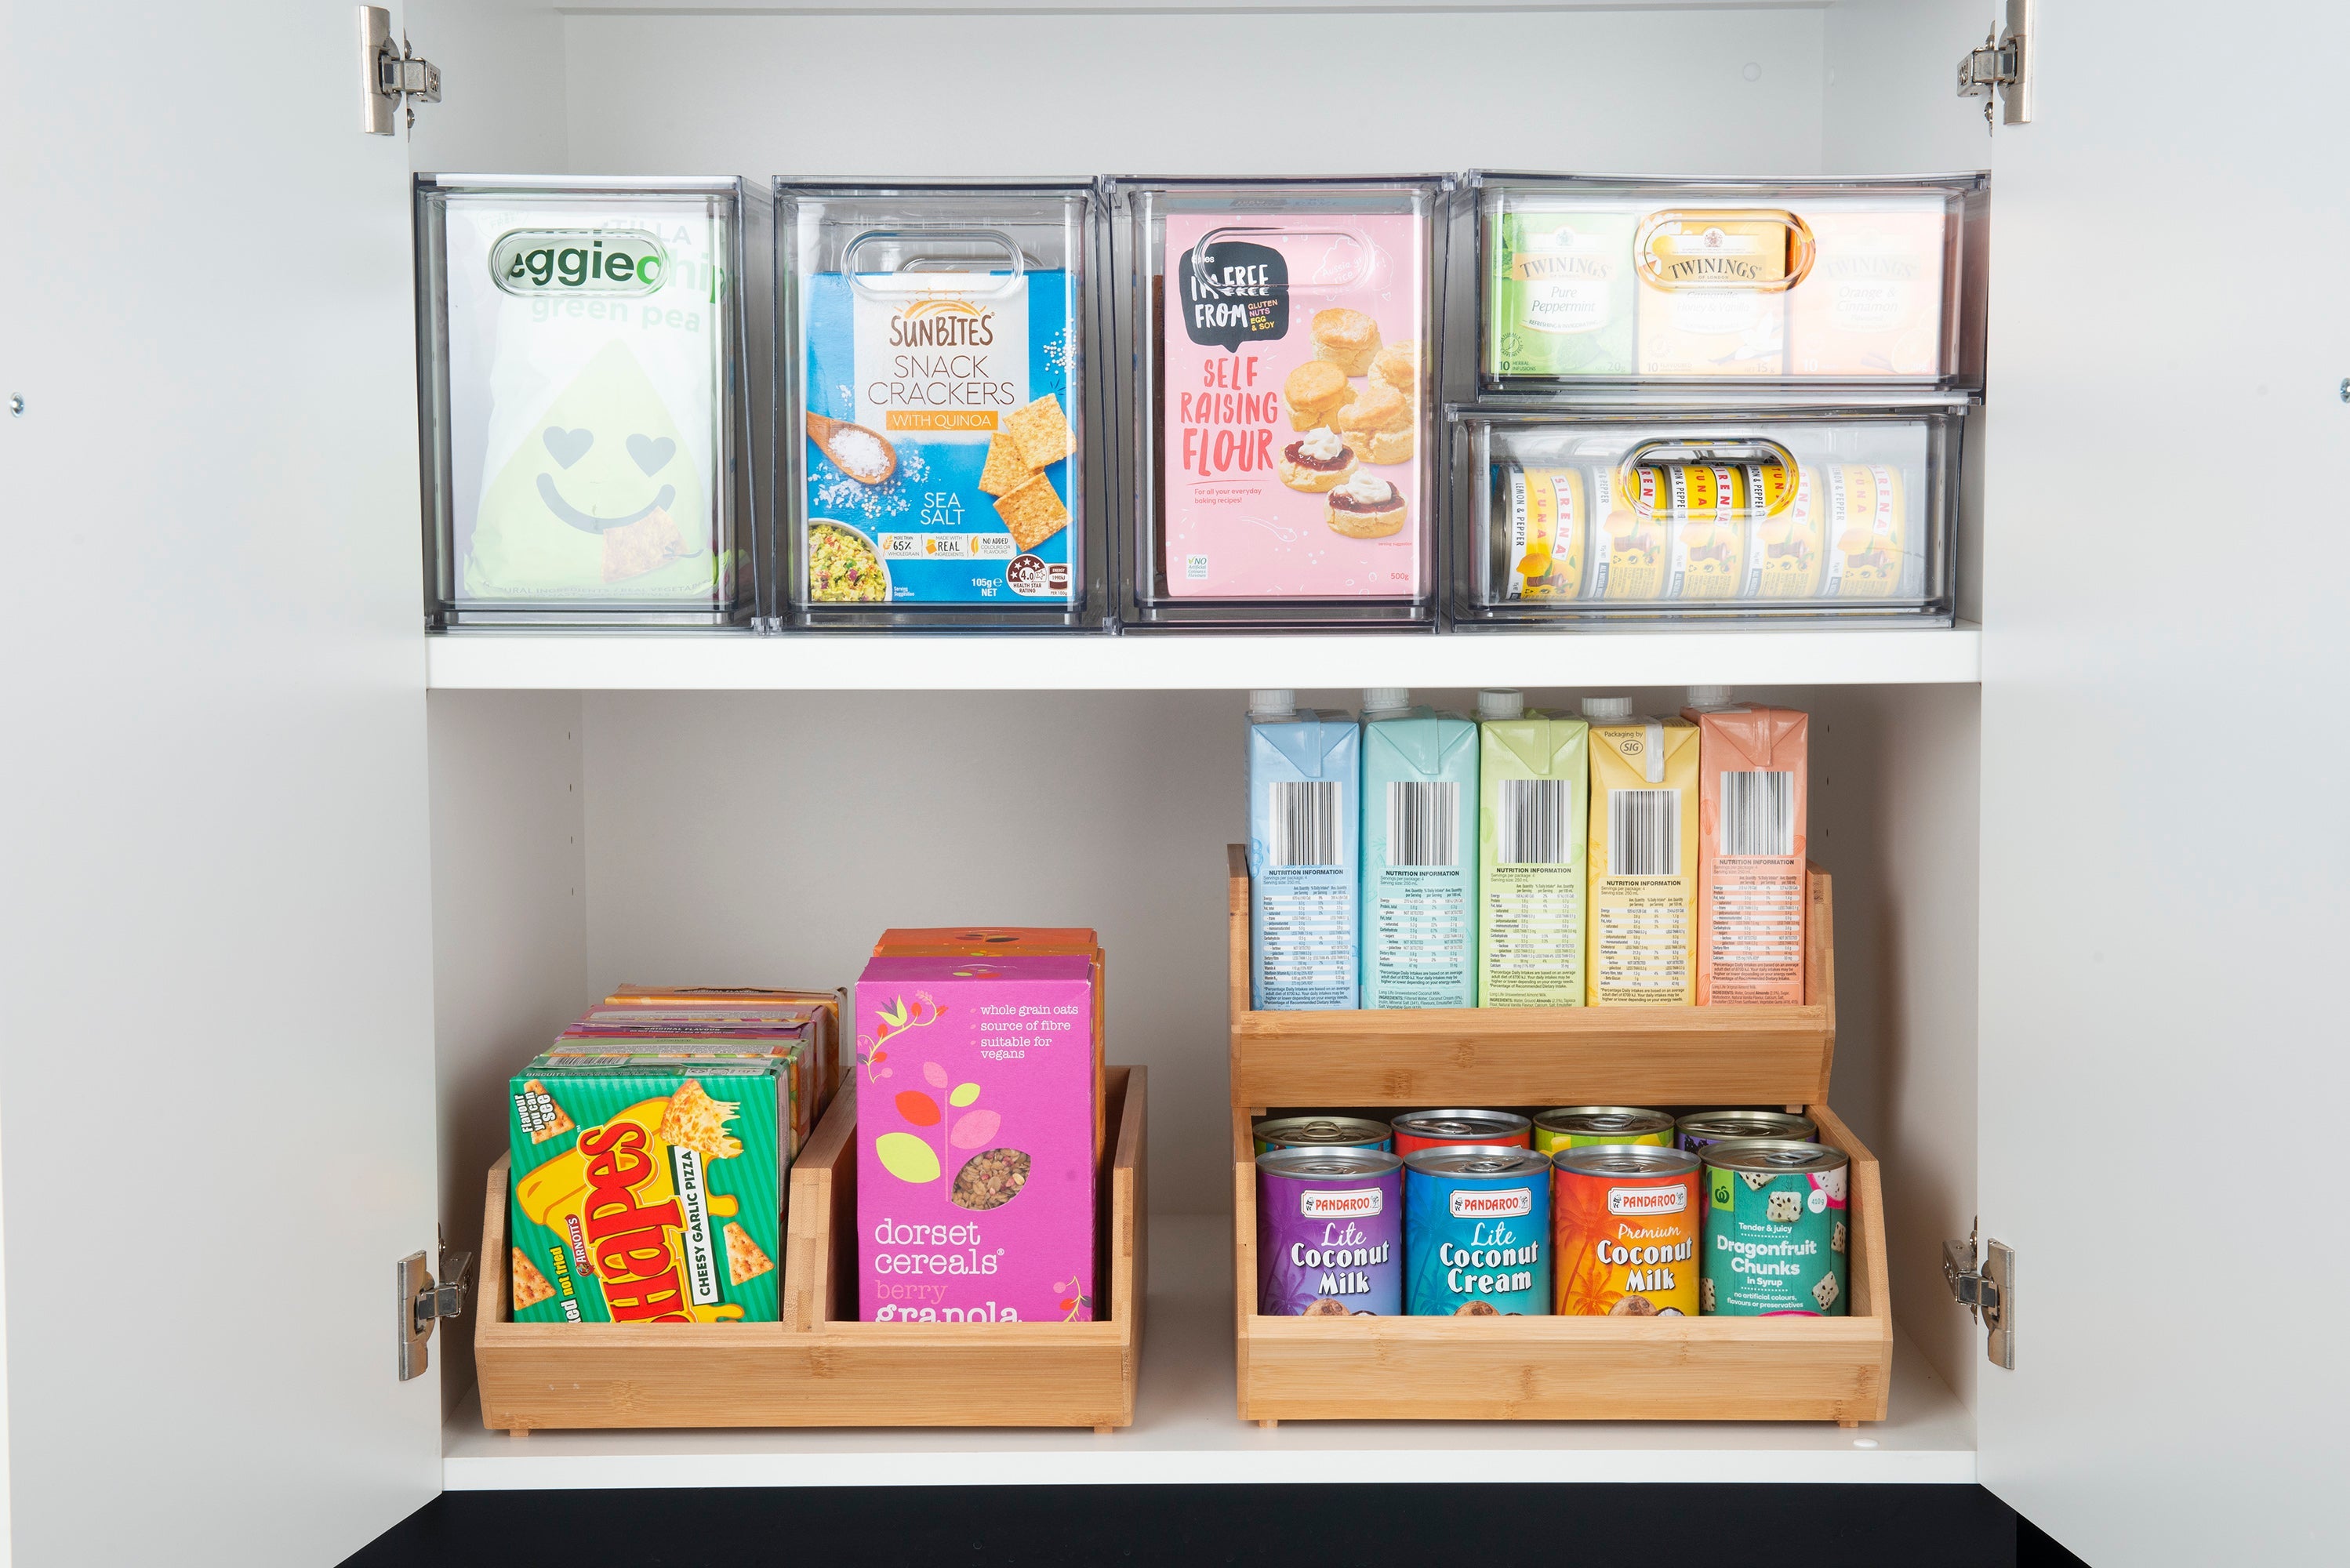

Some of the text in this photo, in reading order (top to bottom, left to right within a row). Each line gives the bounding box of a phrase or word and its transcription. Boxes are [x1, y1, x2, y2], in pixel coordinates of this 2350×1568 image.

[1520, 257, 1609, 278] TWININGS
[1669, 258, 1758, 279] TWININGS
[1551, 286, 1578, 298] Pure
[1839, 286, 1882, 301] Orange
[532, 298, 699, 332] green pea
[1195, 303, 1248, 328] FROM
[1248, 299, 1278, 310] GLUTEN
[1249, 307, 1270, 317] NUTS
[1531, 300, 1596, 314] Peppermint
[1836, 301, 1898, 312] Cinnamon
[889, 314, 993, 347] SUNBITES
[1250, 316, 1266, 325] EGG
[1259, 321, 1275, 330] SOY
[1529, 319, 1556, 328] REFRESHING
[894, 355, 989, 378] SNACK
[1204, 356, 1259, 390] SELF
[1499, 361, 1509, 371] 10
[1647, 363, 1658, 372] 10
[868, 382, 1015, 405] CRACKERS
[1181, 392, 1277, 425] RAISING
[892, 414, 991, 429] WITH QUINOA
[1183, 428, 1273, 476] FLOUR
[1516, 482, 1524, 505] LEMON
[1694, 470, 1707, 506] TUNA
[1854, 471, 1867, 514] TUNA
[1869, 465, 1890, 528] SIRENA
[924, 492, 961, 508] SEA
[1836, 492, 1844, 521] PEPPER
[920, 509, 965, 525] SALT
[1537, 488, 1546, 539] TUNA
[1555, 477, 1571, 554] SIRENA
[1516, 517, 1525, 546] PEPPER
[893, 541, 911, 551] 65%
[938, 542, 960, 551] REAL
[972, 578, 993, 588] 105g
[1020, 570, 1033, 580] 4.0
[981, 588, 997, 597] NET
[980, 1005, 1079, 1017] whole grain oats
[981, 1021, 1071, 1031] source of fibre
[981, 1036, 1052, 1047] suitable for
[981, 1050, 1025, 1061] vegans
[514, 1095, 533, 1133] Flavour
[525, 1091, 545, 1131] you can
[537, 1094, 555, 1121] see
[1316, 1197, 1370, 1211] PANDAROO
[1465, 1197, 1519, 1211] PANDAROO
[1623, 1194, 1676, 1208] PANDAROO
[681, 1151, 710, 1296] CHEESY GARLIC PIZZA
[875, 1218, 981, 1246] dorset
[1321, 1221, 1367, 1247] Lite
[1471, 1221, 1516, 1247] Lite
[1618, 1223, 1681, 1240] Premium
[1738, 1222, 1764, 1232] Tender
[568, 1218, 587, 1263] ARNOTT'S
[1596, 1236, 1693, 1265] Coconut
[1717, 1235, 1817, 1259] Dragonfruit
[1291, 1240, 1389, 1268] Coconut
[1440, 1240, 1538, 1268] Coconut
[550, 1247, 574, 1296] not fried
[1731, 1258, 1800, 1275] Chunks
[1318, 1271, 1370, 1295] Milk
[1447, 1269, 1532, 1294] Cream
[1625, 1268, 1676, 1292] Milk
[1756, 1278, 1783, 1287] Syrup
[875, 1280, 948, 1305] berry
[1727, 1298, 1751, 1306] flavours
[875, 1301, 1022, 1323] granola
